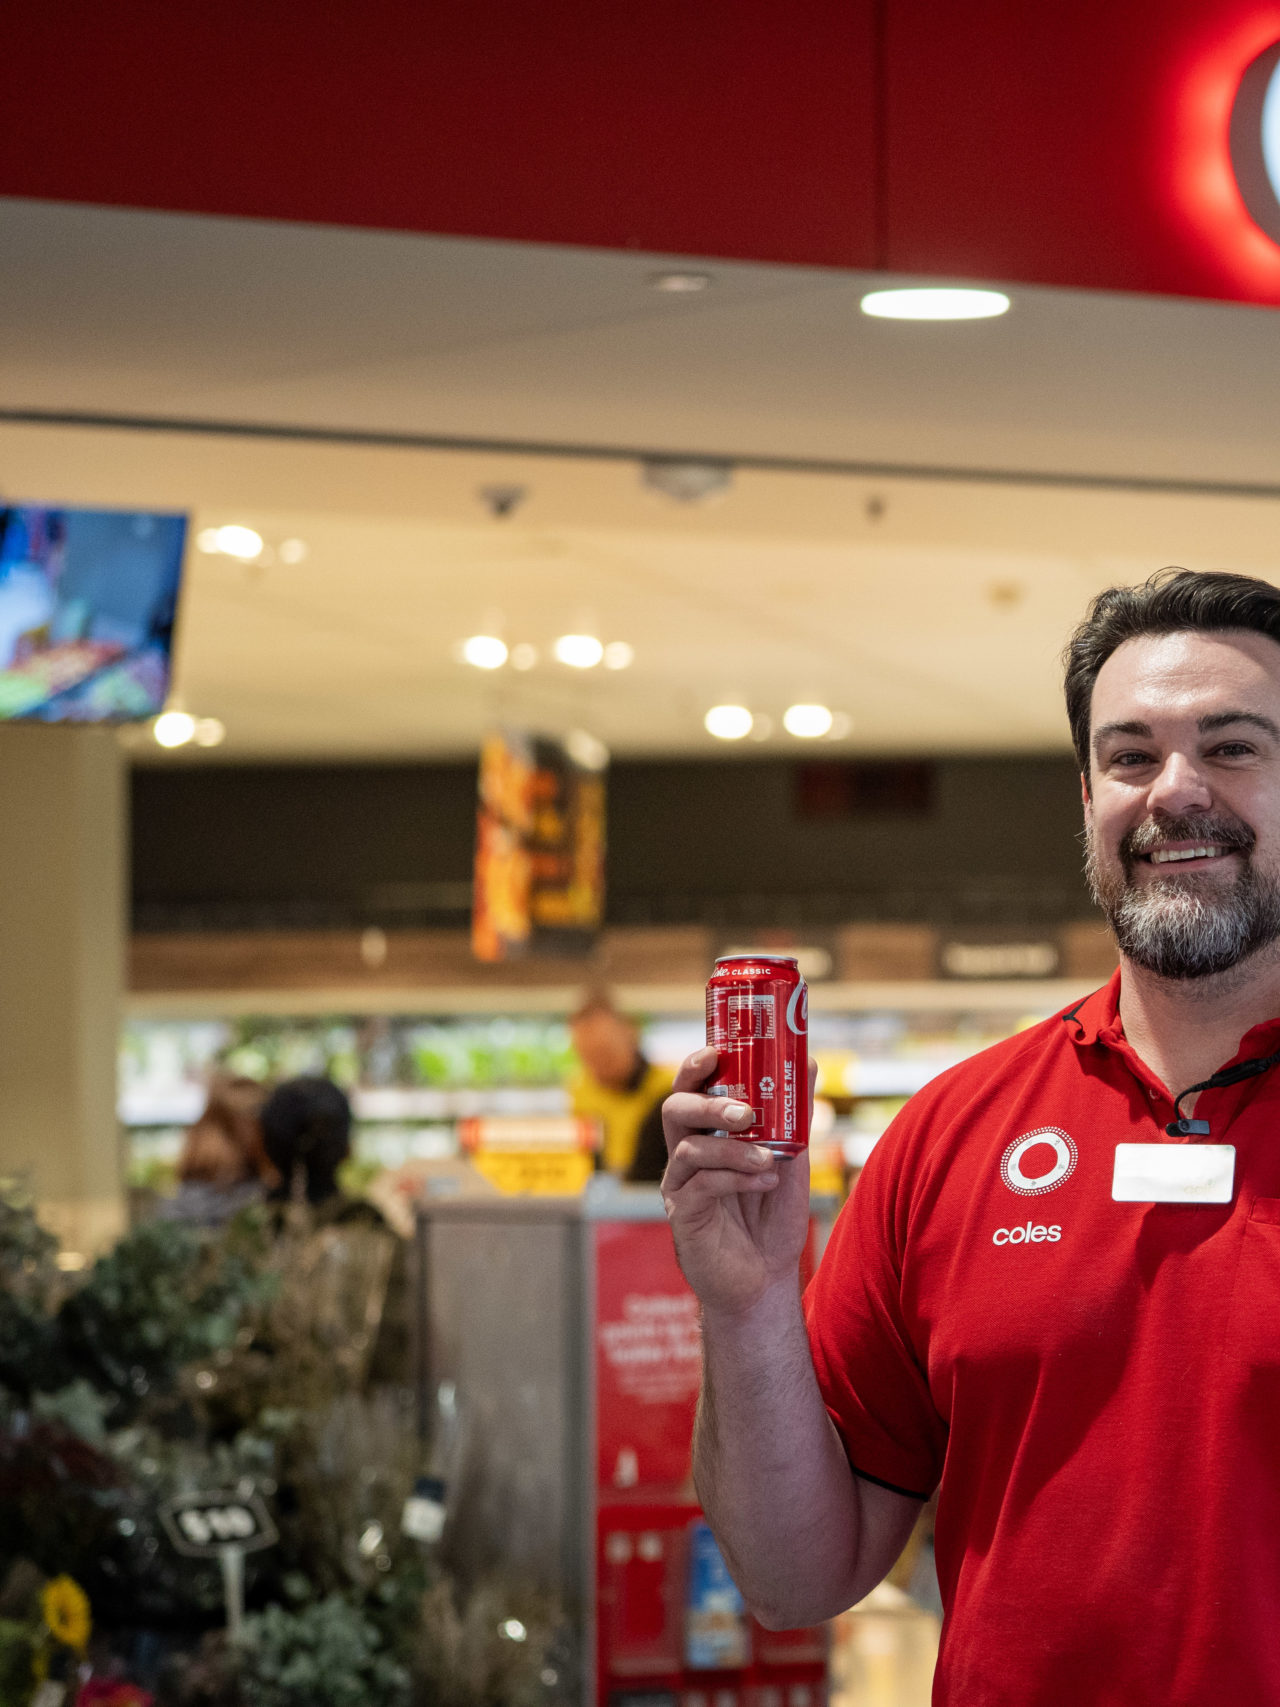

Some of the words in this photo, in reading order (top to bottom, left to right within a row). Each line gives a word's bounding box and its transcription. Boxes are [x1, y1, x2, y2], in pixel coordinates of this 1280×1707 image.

[731, 968, 771, 976] CLASSIC
[784, 1060, 793, 1080] ME
[784, 1083, 793, 1139] RECYCLE
[992, 1221, 1062, 1246] coles
